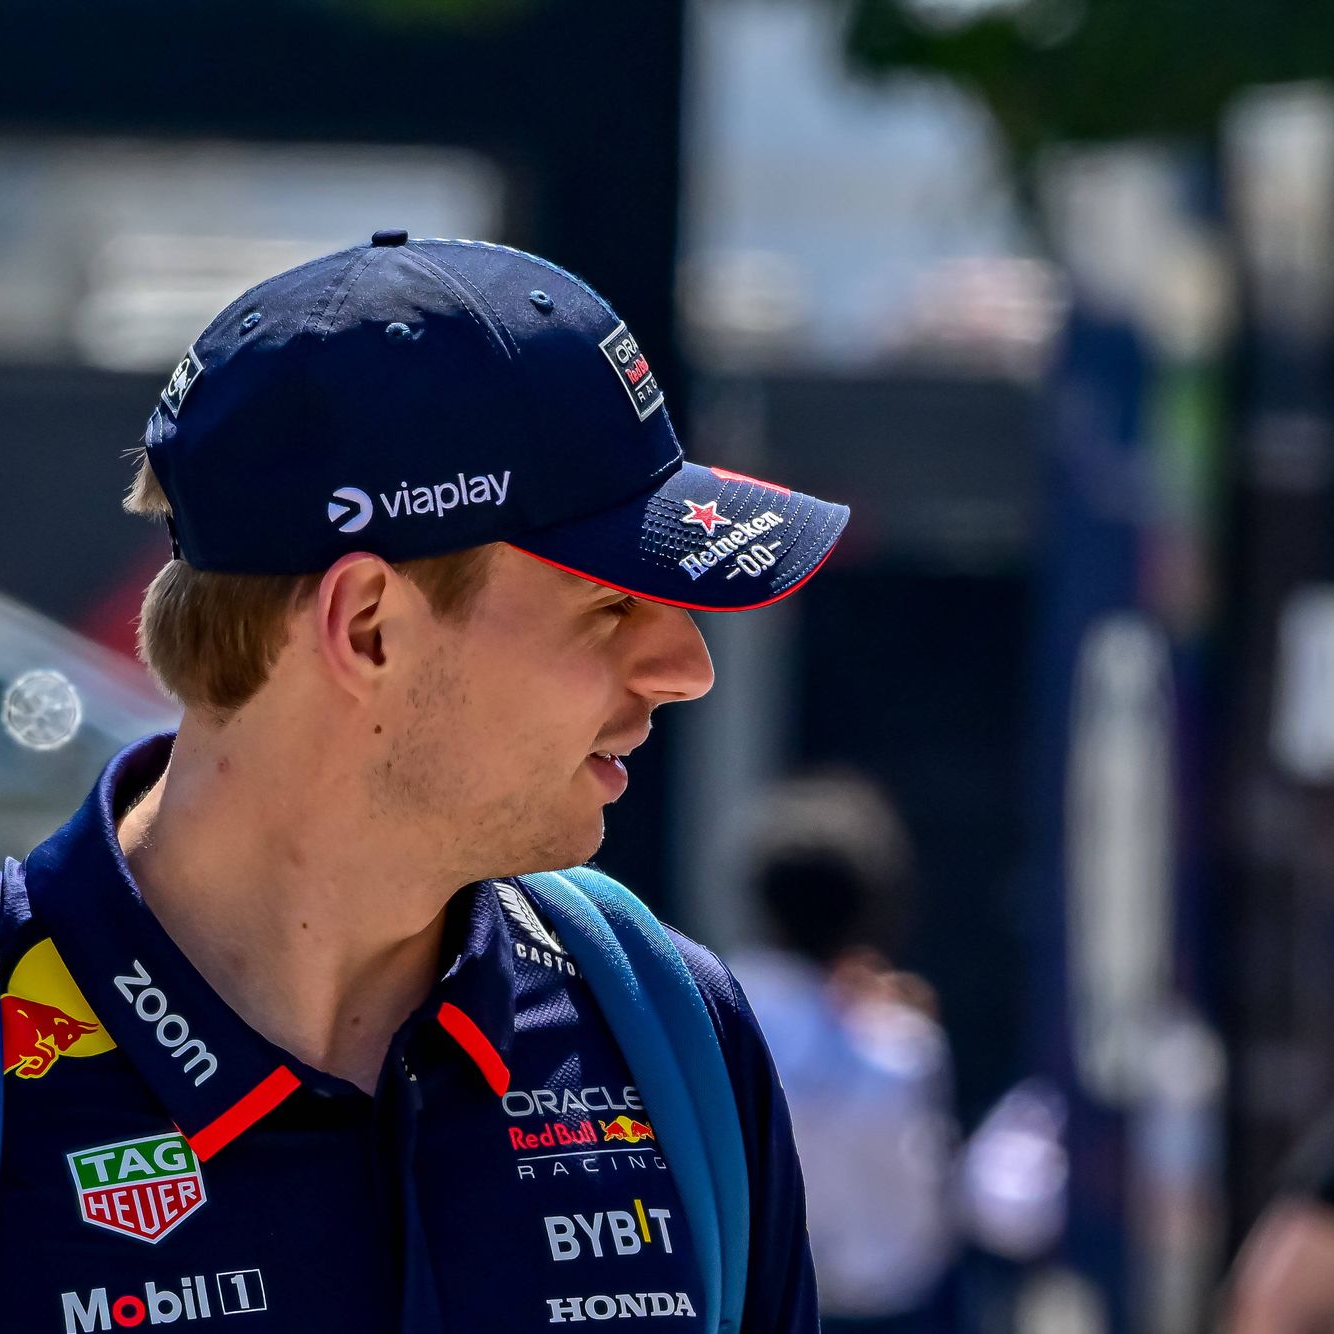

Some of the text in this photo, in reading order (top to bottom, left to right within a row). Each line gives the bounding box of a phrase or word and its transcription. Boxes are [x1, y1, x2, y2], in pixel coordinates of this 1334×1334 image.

[379, 470, 511, 518] viaplay
[678, 510, 784, 581] Heineken
[516, 943, 577, 977] CASTO
[113, 959, 218, 1087] zoom
[501, 1085, 645, 1117] ORACLE
[80, 1140, 188, 1183] TAG
[517, 1156, 667, 1180] RACING
[88, 1180, 198, 1235] HEUER
[544, 1199, 673, 1262] BYBIT
[230, 1273, 251, 1310] 1
[546, 1292, 697, 1323] HONDA
